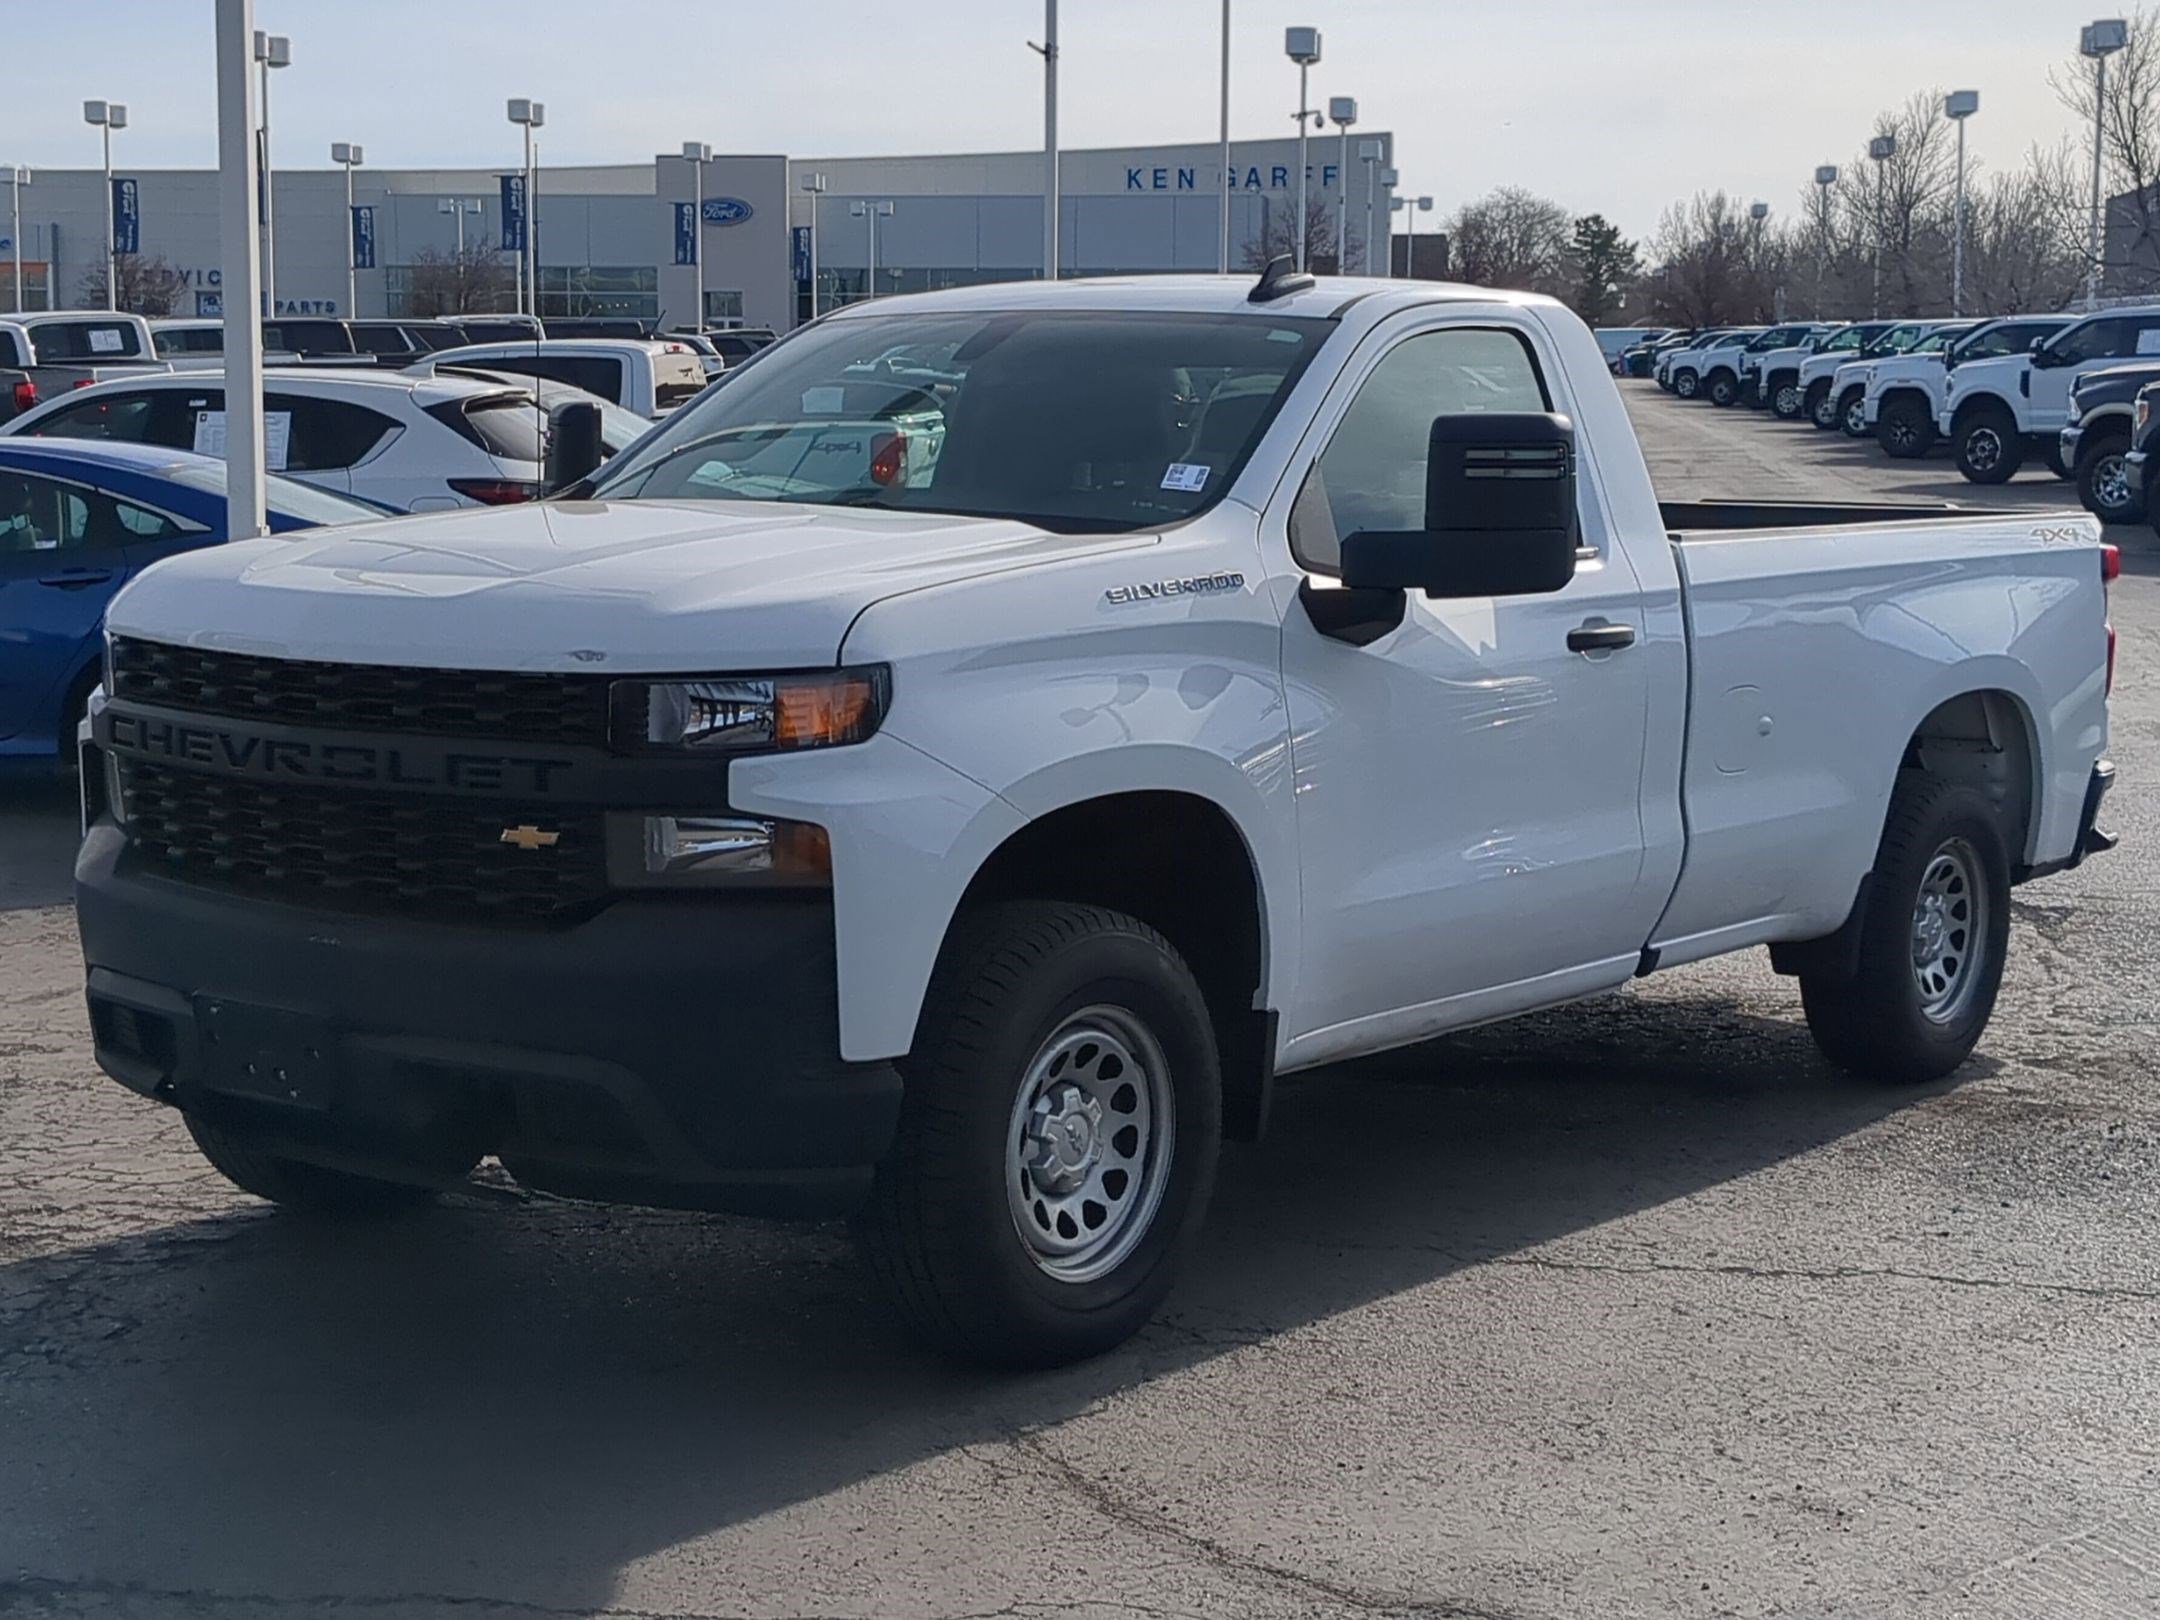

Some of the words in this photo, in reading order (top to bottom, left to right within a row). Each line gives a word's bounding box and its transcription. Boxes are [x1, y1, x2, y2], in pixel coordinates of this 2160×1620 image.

[1127, 168, 1194, 189] KEN
[703, 203, 737, 218] Ford
[275, 301, 335, 314] PARTS
[1106, 573, 1245, 604] SILVERADO
[108, 713, 573, 792] CHEVROLET
